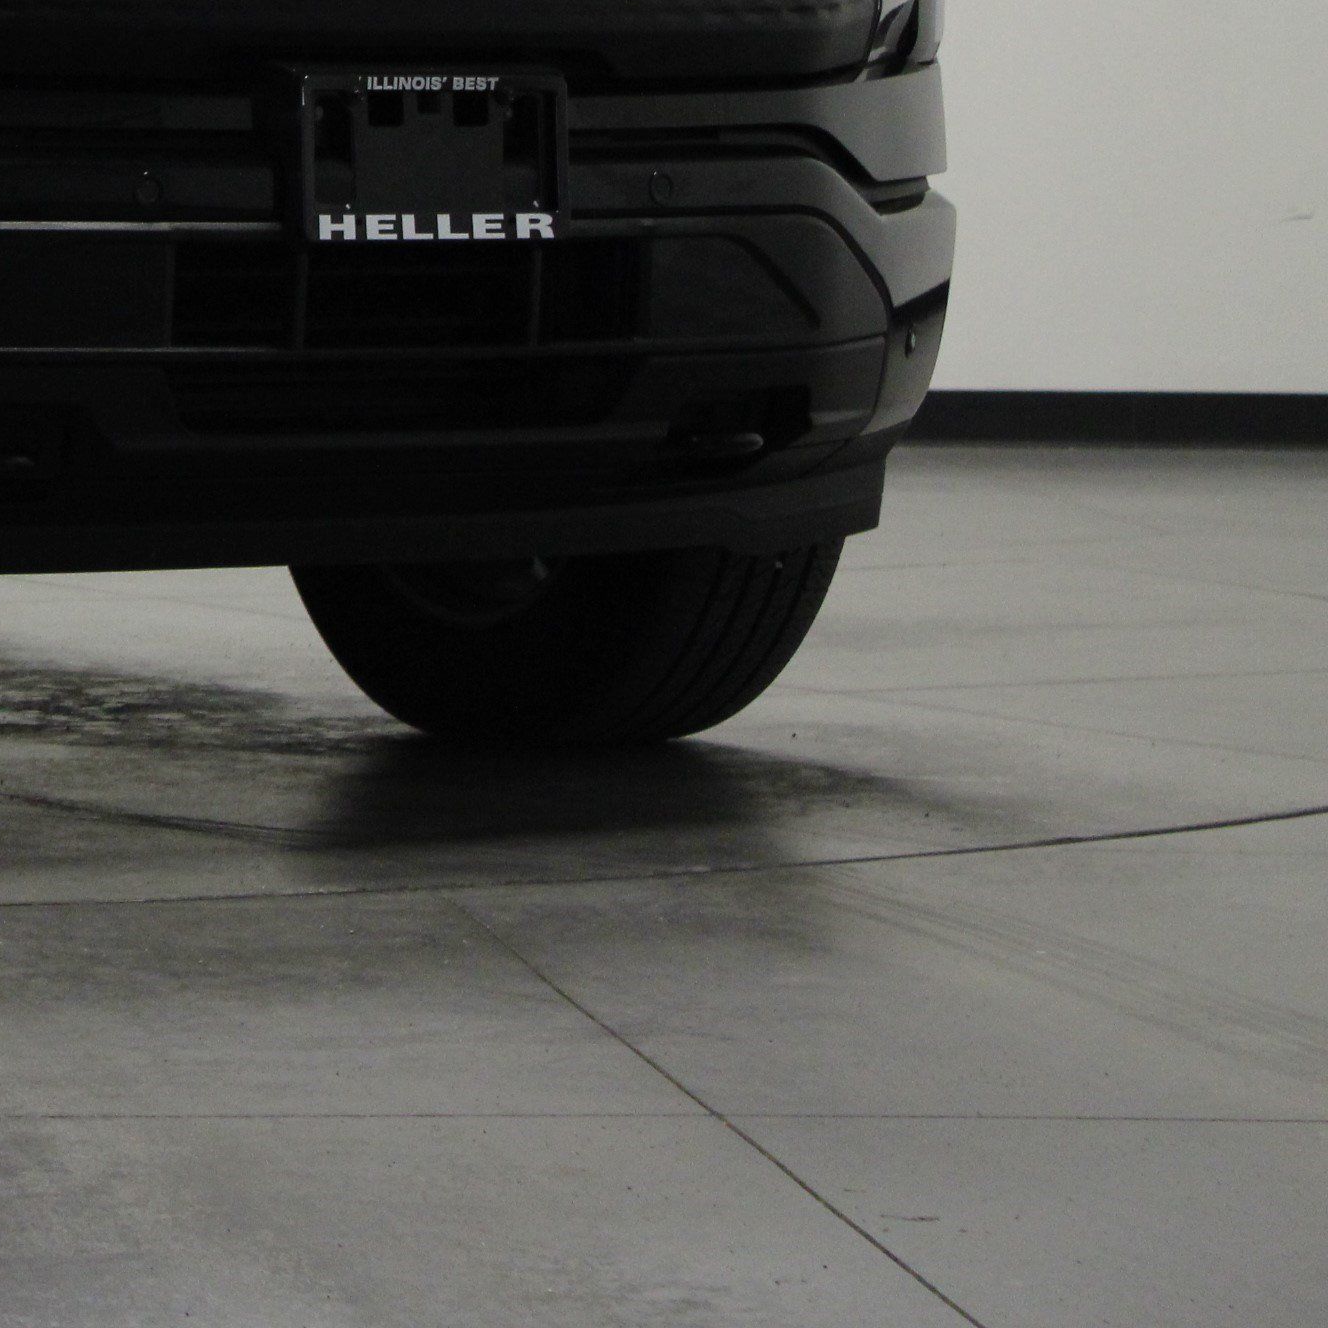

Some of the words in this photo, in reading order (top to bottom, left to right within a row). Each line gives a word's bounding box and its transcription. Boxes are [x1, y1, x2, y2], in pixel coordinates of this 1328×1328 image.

[367, 76, 448, 91] ILLINOIS'
[452, 76, 499, 91] BEST
[318, 213, 555, 240] HELLER
